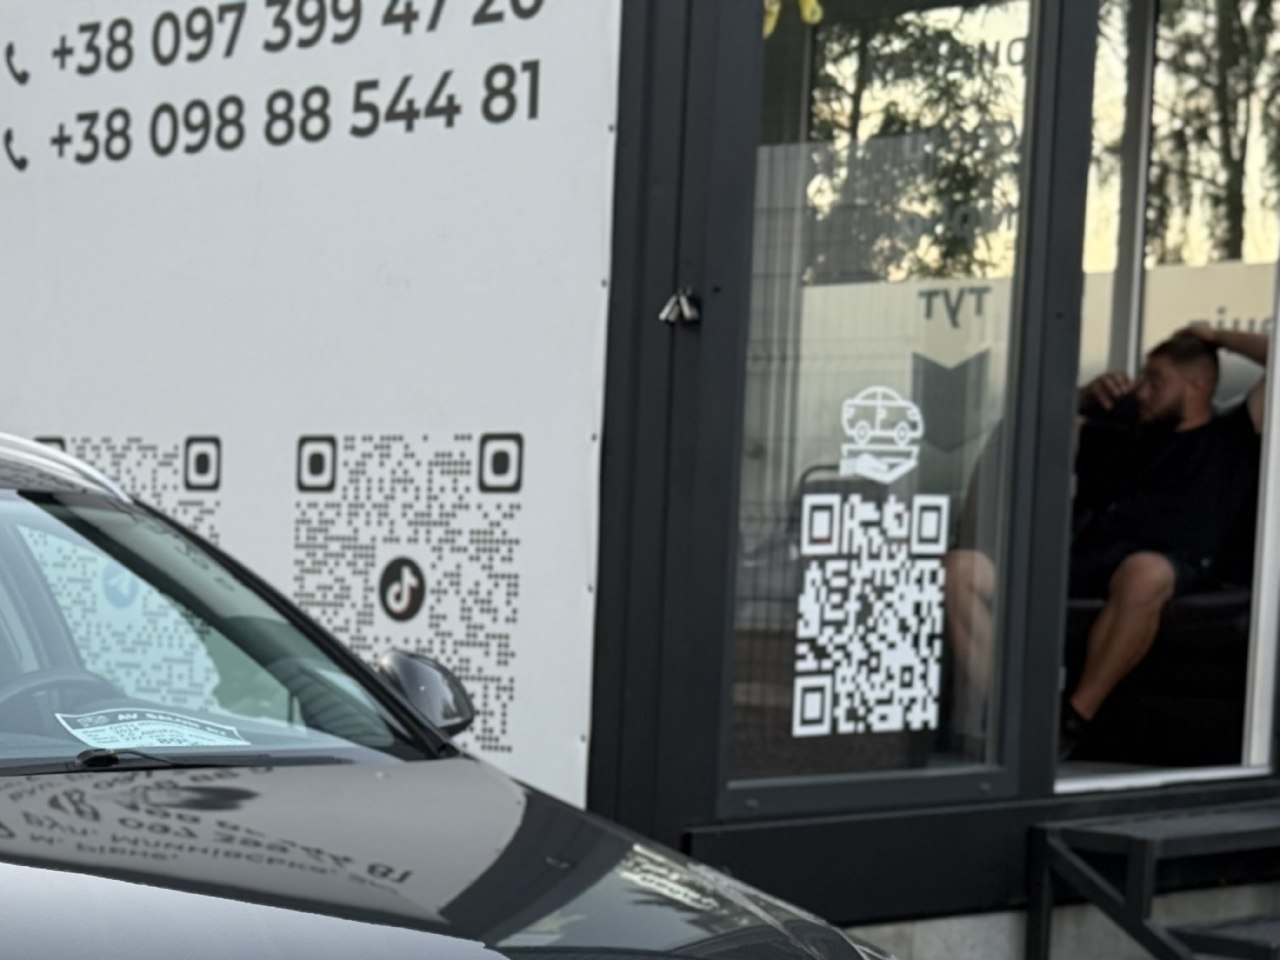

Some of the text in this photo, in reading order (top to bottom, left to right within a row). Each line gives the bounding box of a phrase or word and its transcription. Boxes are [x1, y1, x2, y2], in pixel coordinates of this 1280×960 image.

[50, 17, 134, 77] +38
[151, 0, 247, 67] 097
[263, 0, 363, 53] 399
[50, 59, 540, 165] +38 098 88 544 81
